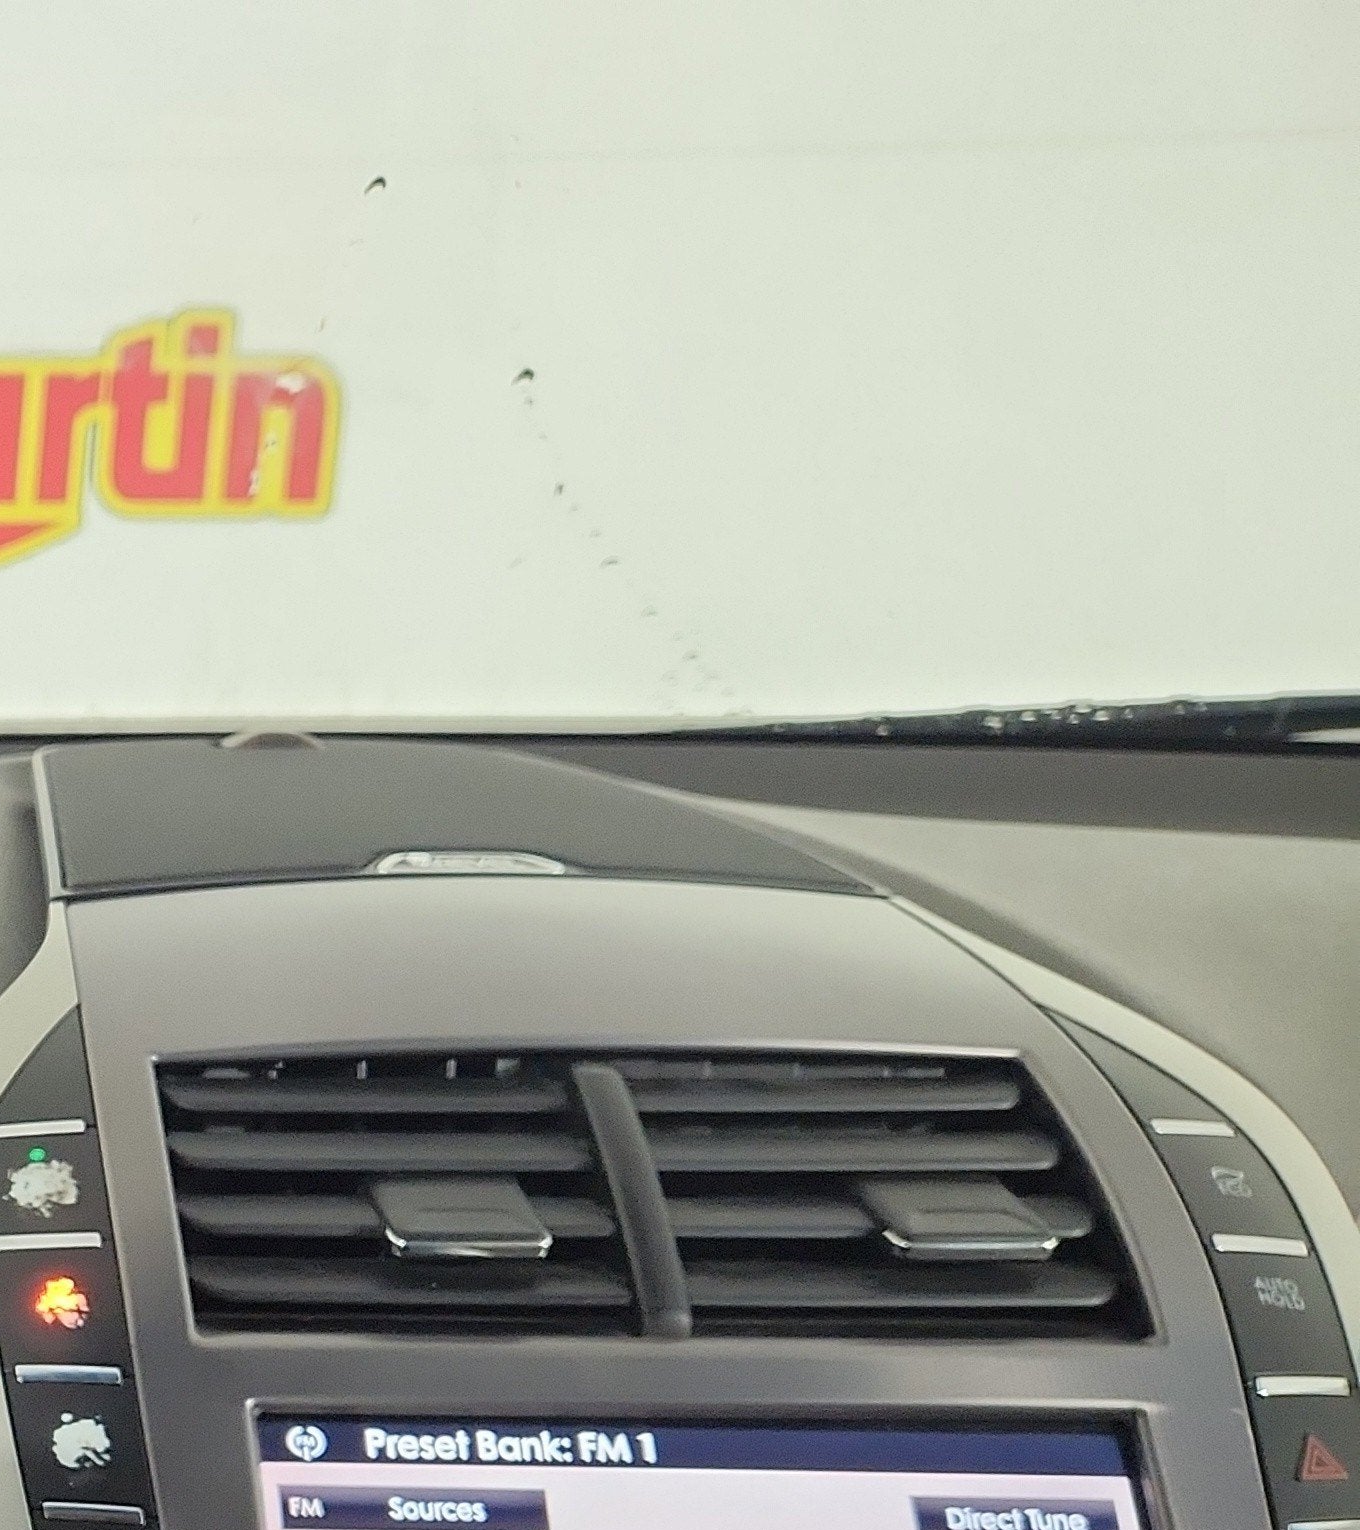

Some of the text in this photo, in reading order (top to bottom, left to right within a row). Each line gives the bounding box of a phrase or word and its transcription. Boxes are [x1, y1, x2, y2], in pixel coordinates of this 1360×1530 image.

[362, 1427, 471, 1462] Preset
[476, 1429, 574, 1463] Bank:
[577, 1432, 635, 1465] FM
[635, 1432, 659, 1465] 1
[287, 1496, 489, 1523] FM Sources
